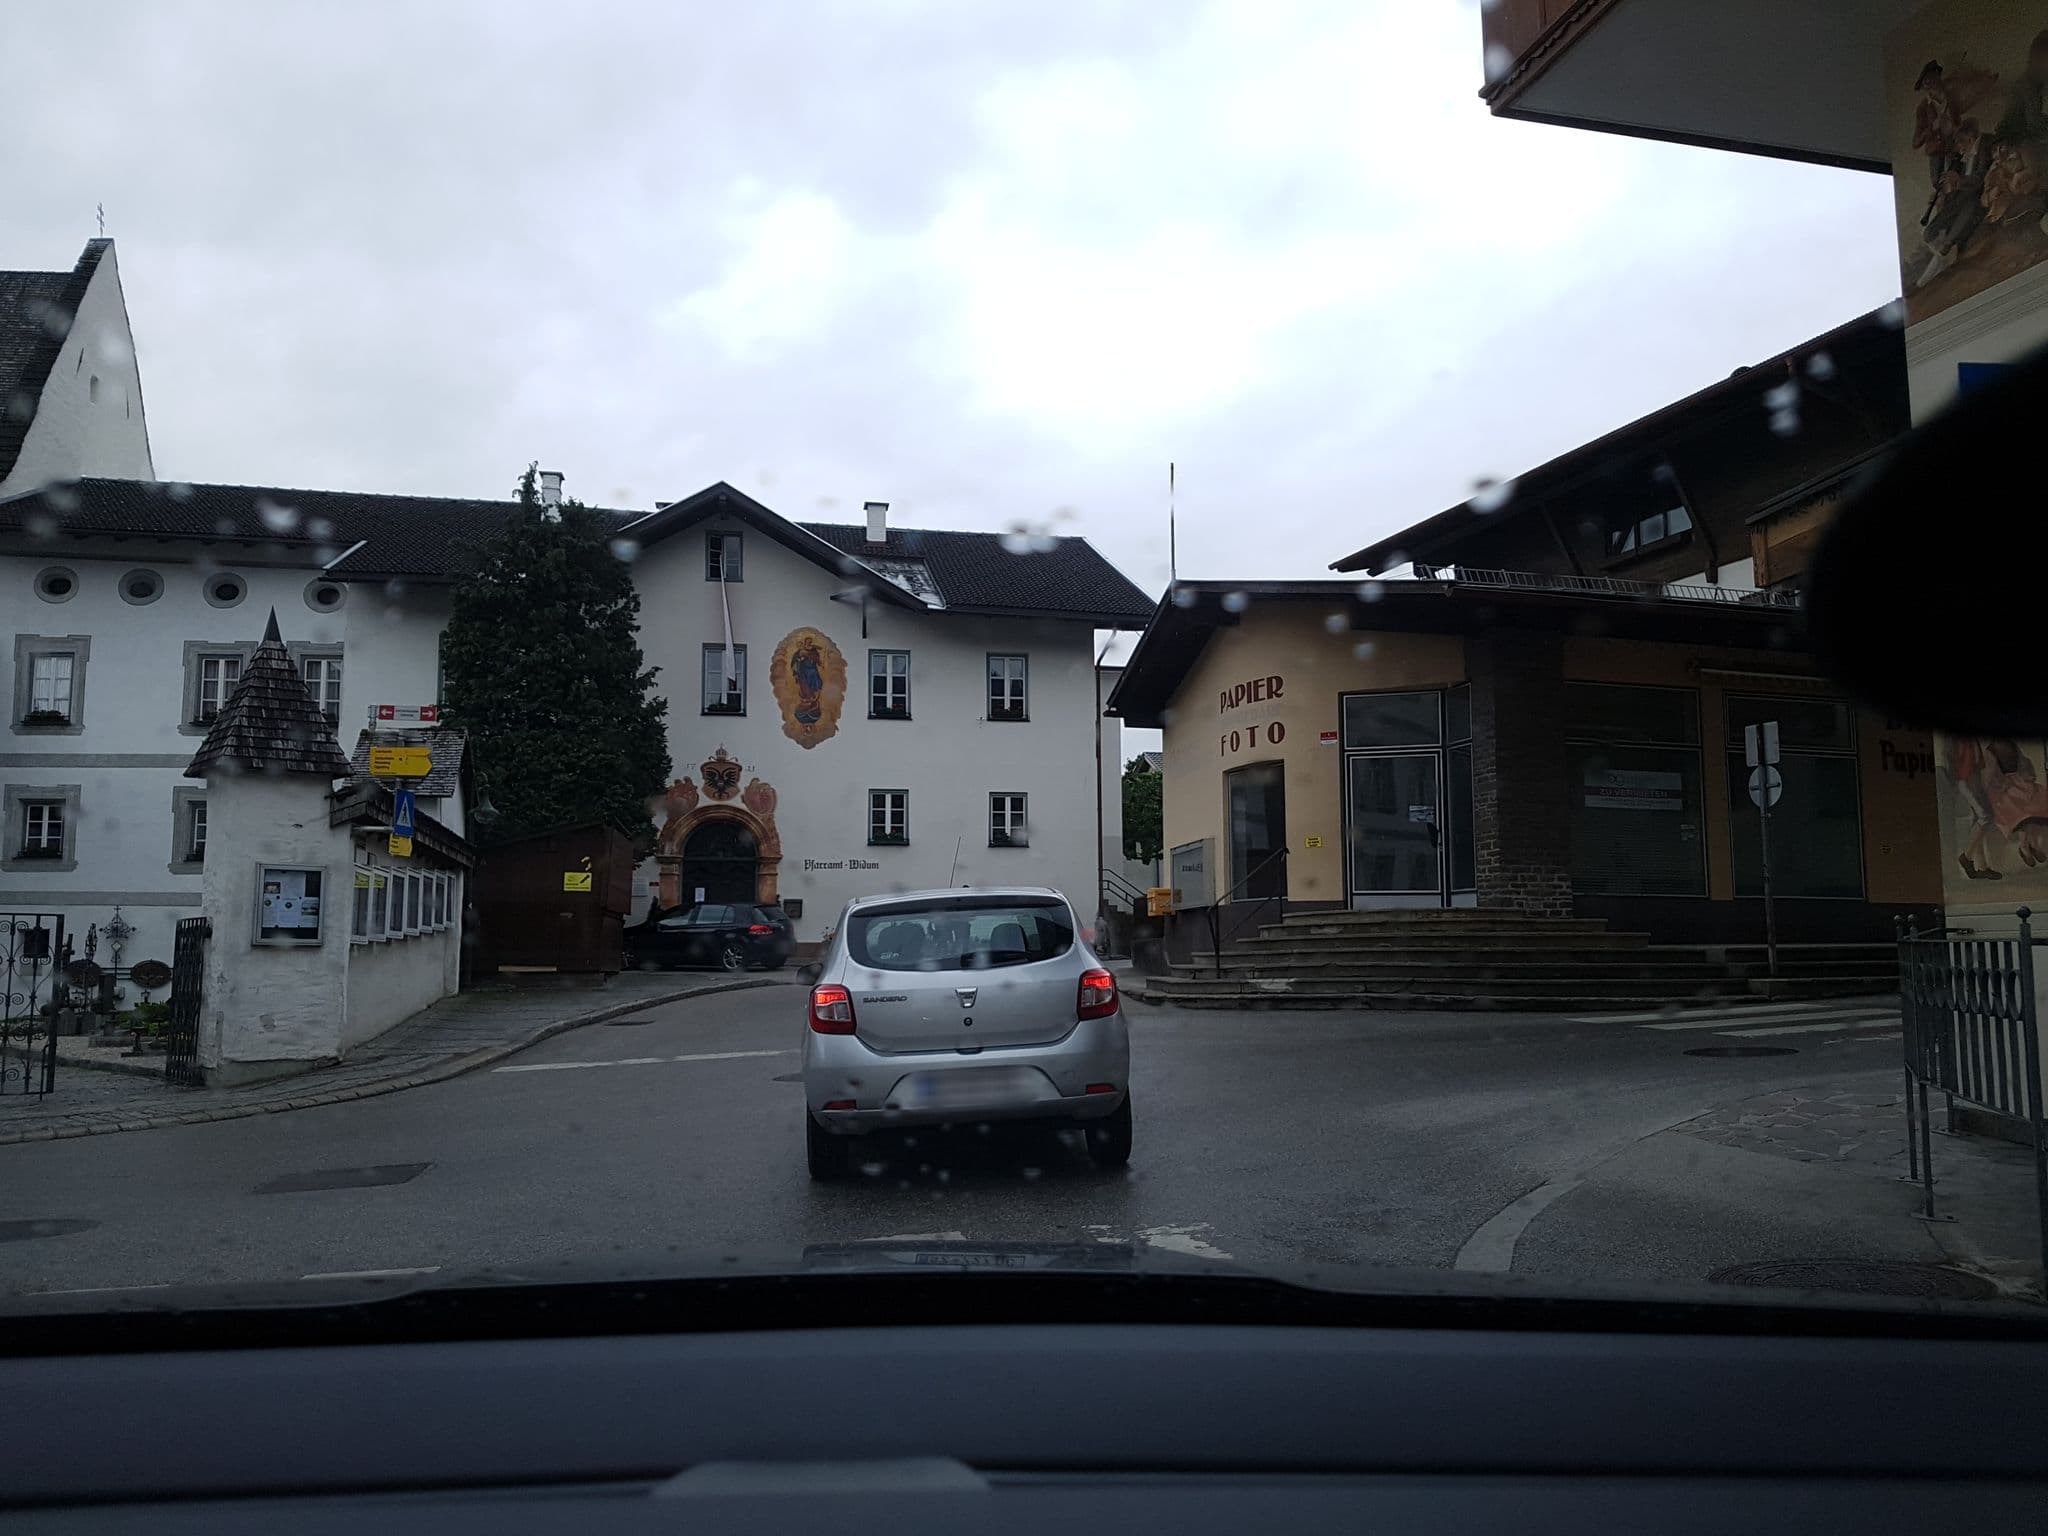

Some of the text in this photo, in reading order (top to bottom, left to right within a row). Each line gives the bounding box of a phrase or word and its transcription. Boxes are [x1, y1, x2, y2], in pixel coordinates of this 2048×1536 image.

[1220, 675, 1284, 714] PAPIER
[1221, 721, 1286, 757] FOTO
[803, 858, 844, 871] Pfarramt
[849, 858, 880, 870] Widum
[862, 995, 908, 1003] SANDERO
